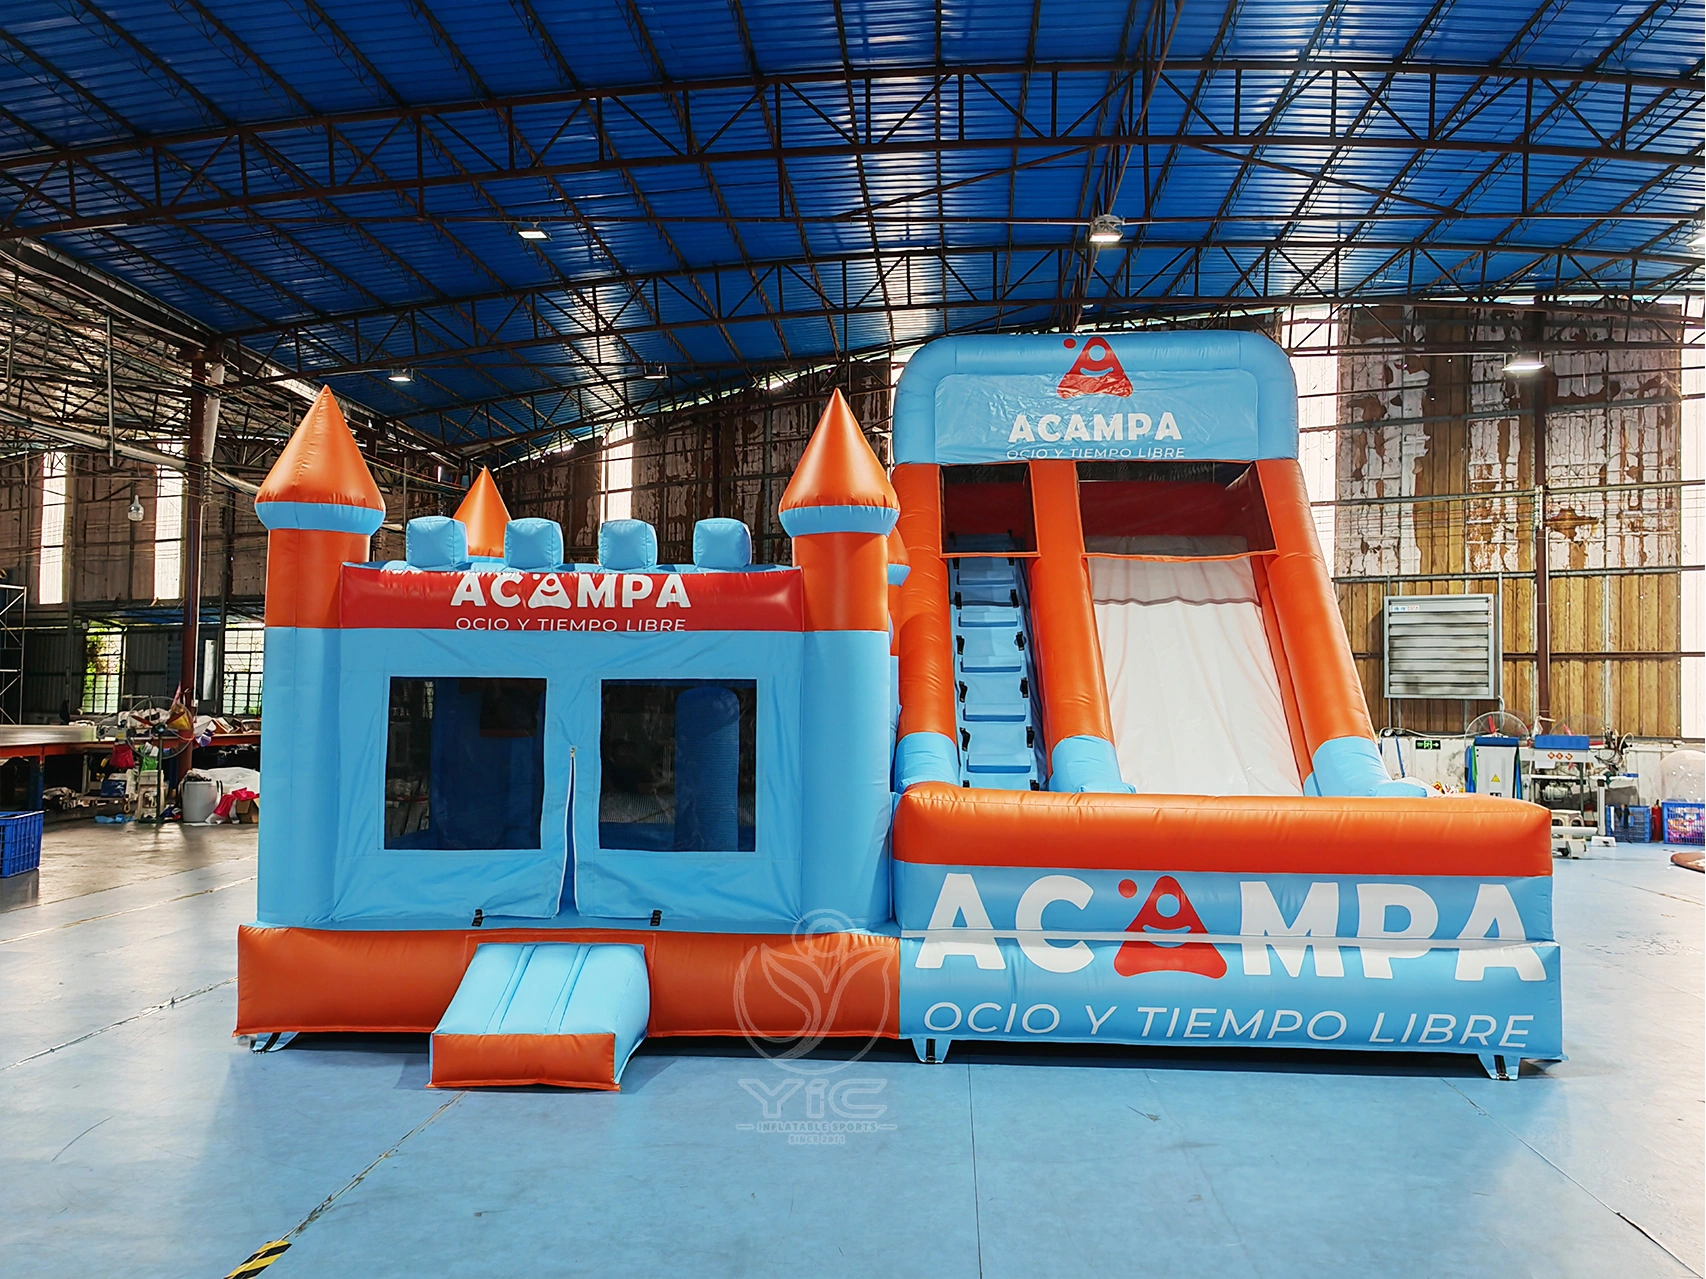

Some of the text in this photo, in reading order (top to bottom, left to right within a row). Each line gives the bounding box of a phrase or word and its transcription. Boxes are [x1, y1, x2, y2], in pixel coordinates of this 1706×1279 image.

[1008, 411, 1182, 443] ACAMPA
[1006, 447, 1185, 460] OCIO Y TIEMPO LIBRE
[450, 573, 692, 609] ACAMPA
[455, 617, 686, 632] OCIO Y TIEMPO LIBRE
[915, 872, 1547, 982] ACAMPA
[923, 1001, 1534, 1048] OCIO Y TIEMPO LIBRE
